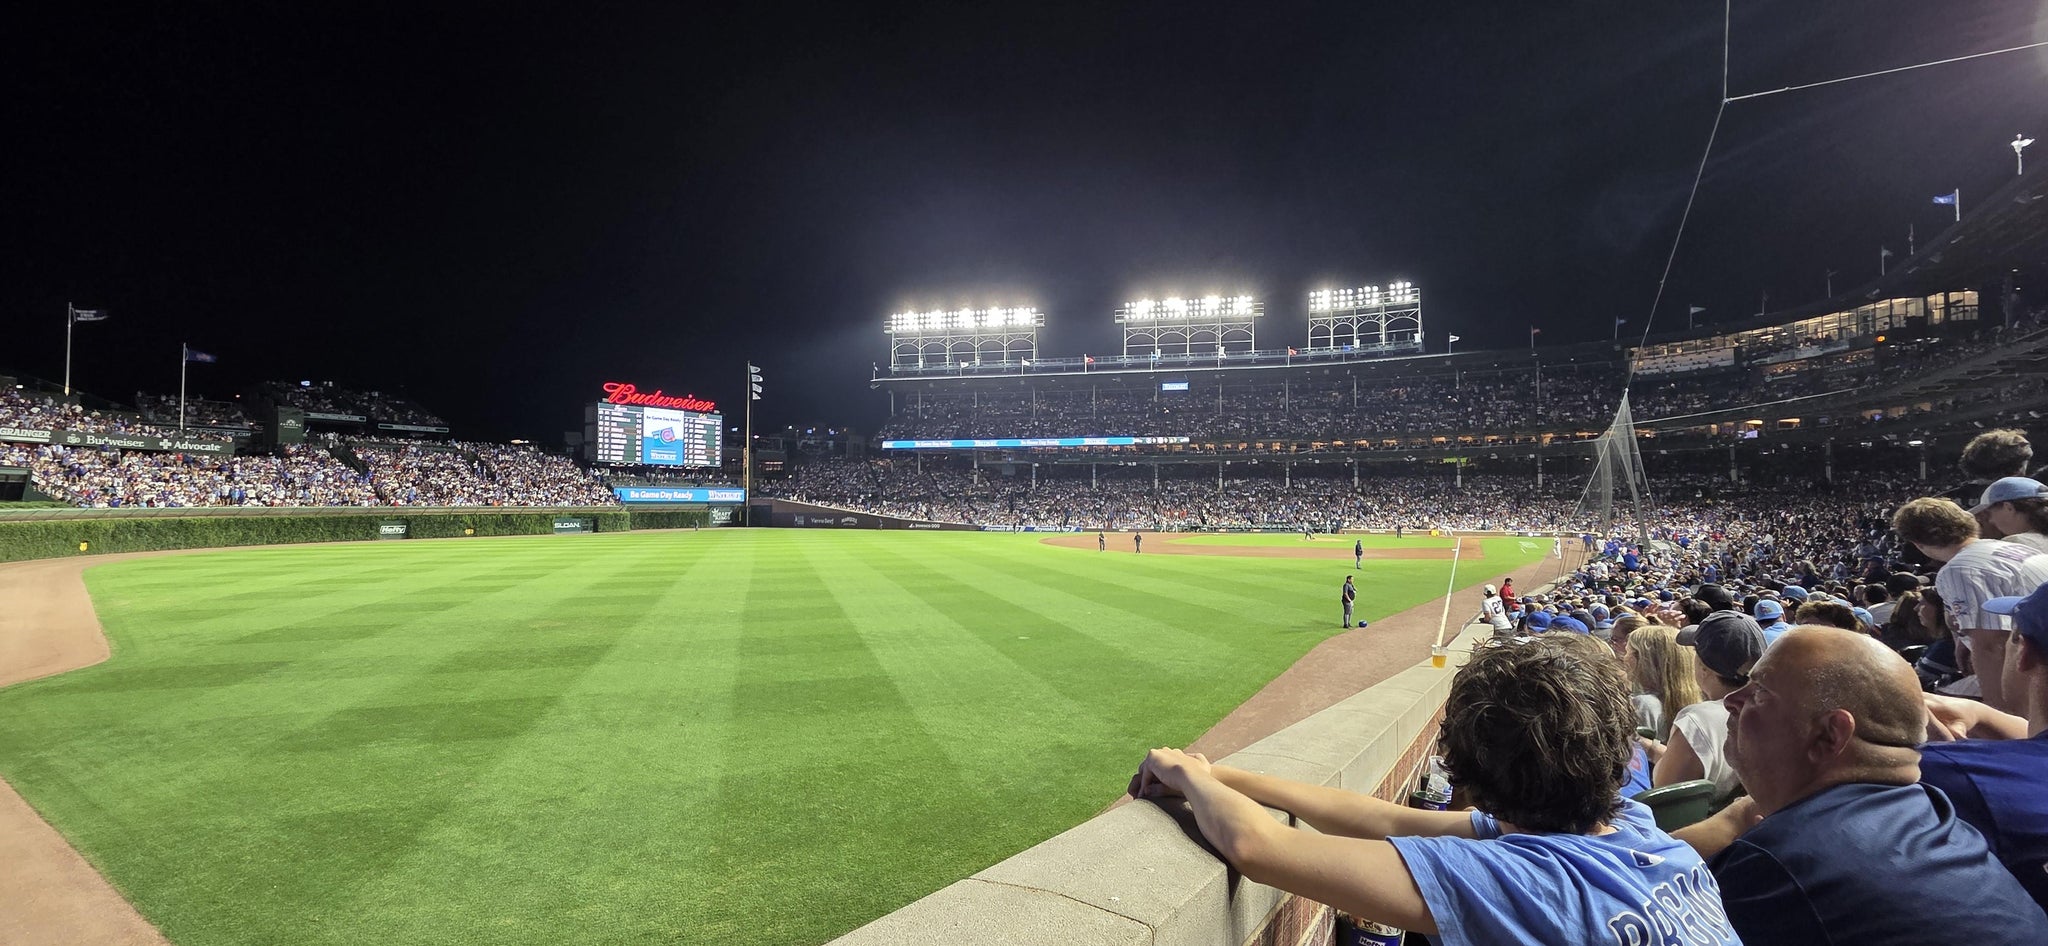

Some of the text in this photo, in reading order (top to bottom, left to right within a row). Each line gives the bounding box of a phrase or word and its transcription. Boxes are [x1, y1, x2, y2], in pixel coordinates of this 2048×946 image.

[603, 382, 715, 411] Budweiser
[0, 427, 51, 439] GRAINGER
[86, 435, 145, 448] Budweiser
[174, 441, 223, 452] Advocate
[630, 490, 693, 501] Be Game Day Ready
[381, 525, 405, 534] Hefty
